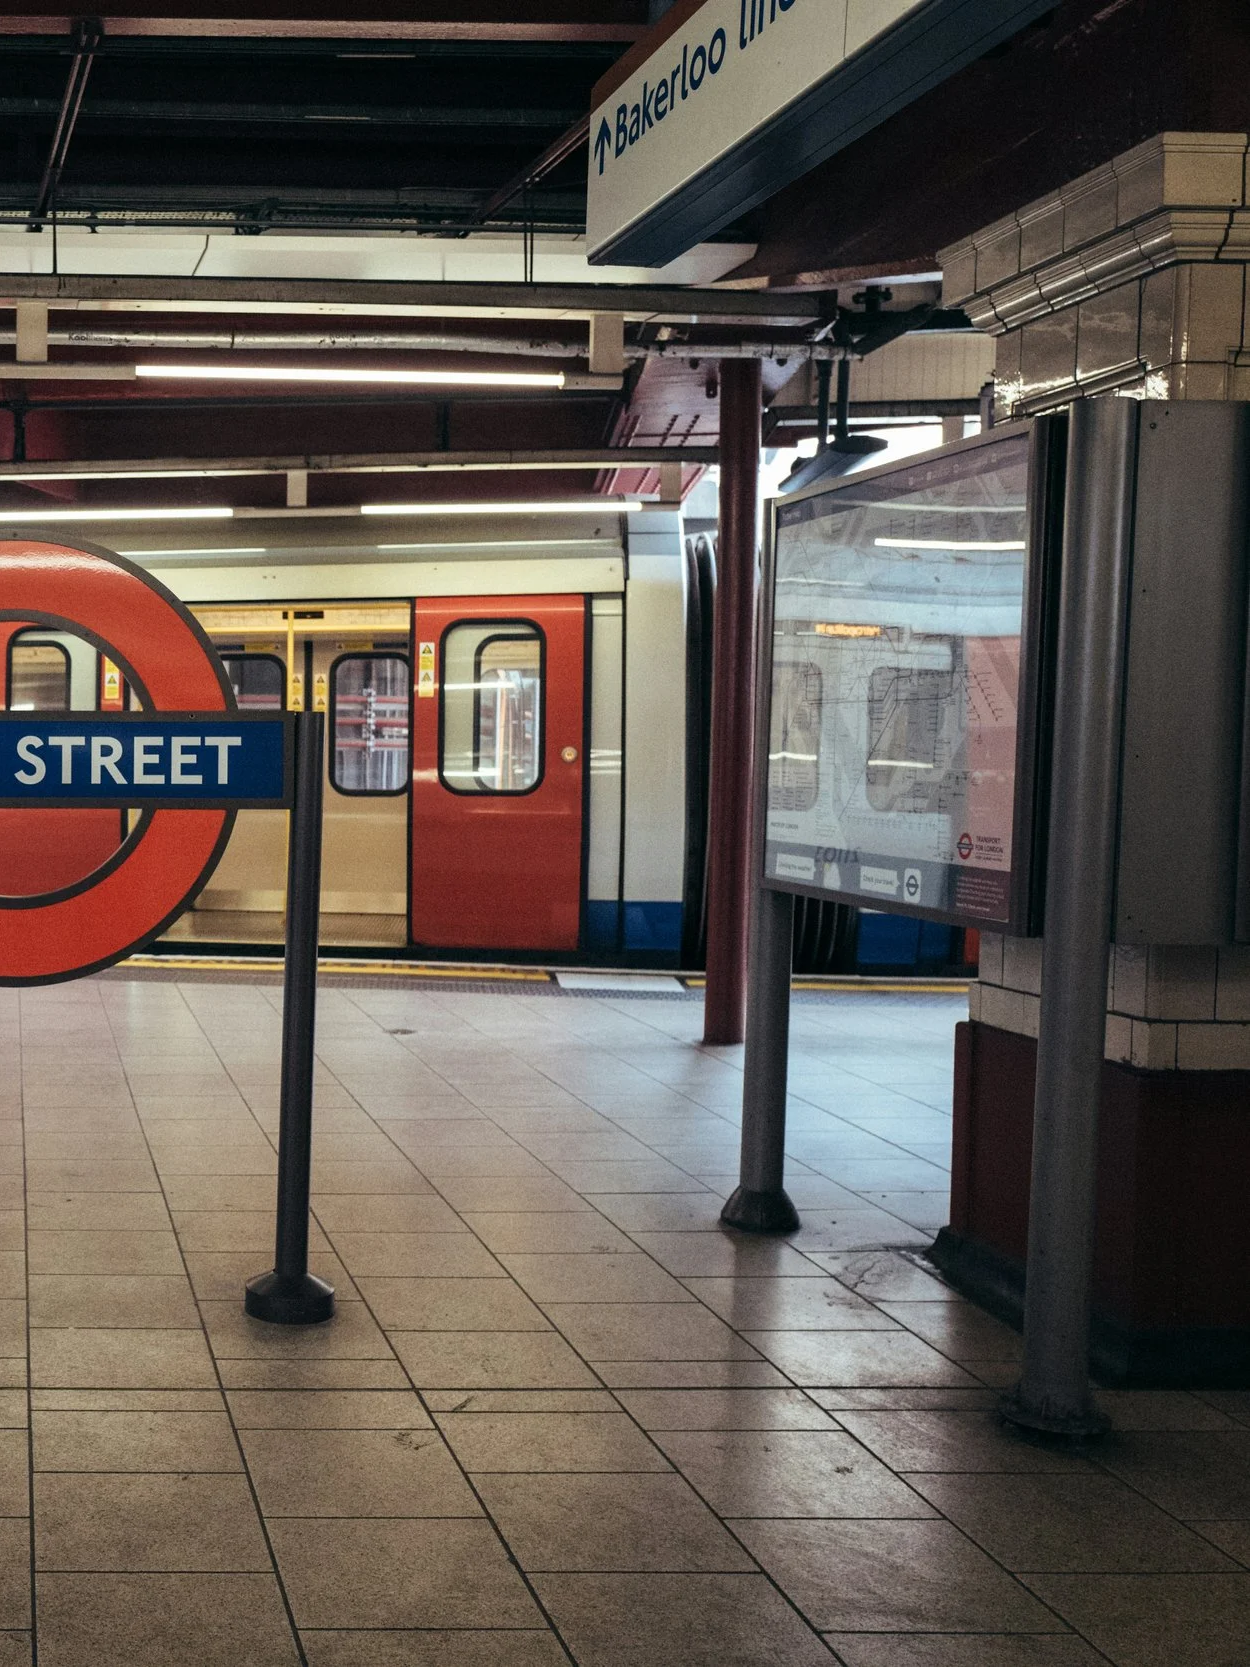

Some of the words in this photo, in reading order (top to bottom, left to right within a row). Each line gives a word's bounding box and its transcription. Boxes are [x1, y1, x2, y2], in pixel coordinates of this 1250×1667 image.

[614, 27, 727, 159] Bakerloo
[739, 0, 796, 50] lin
[13, 735, 242, 785] STREET
